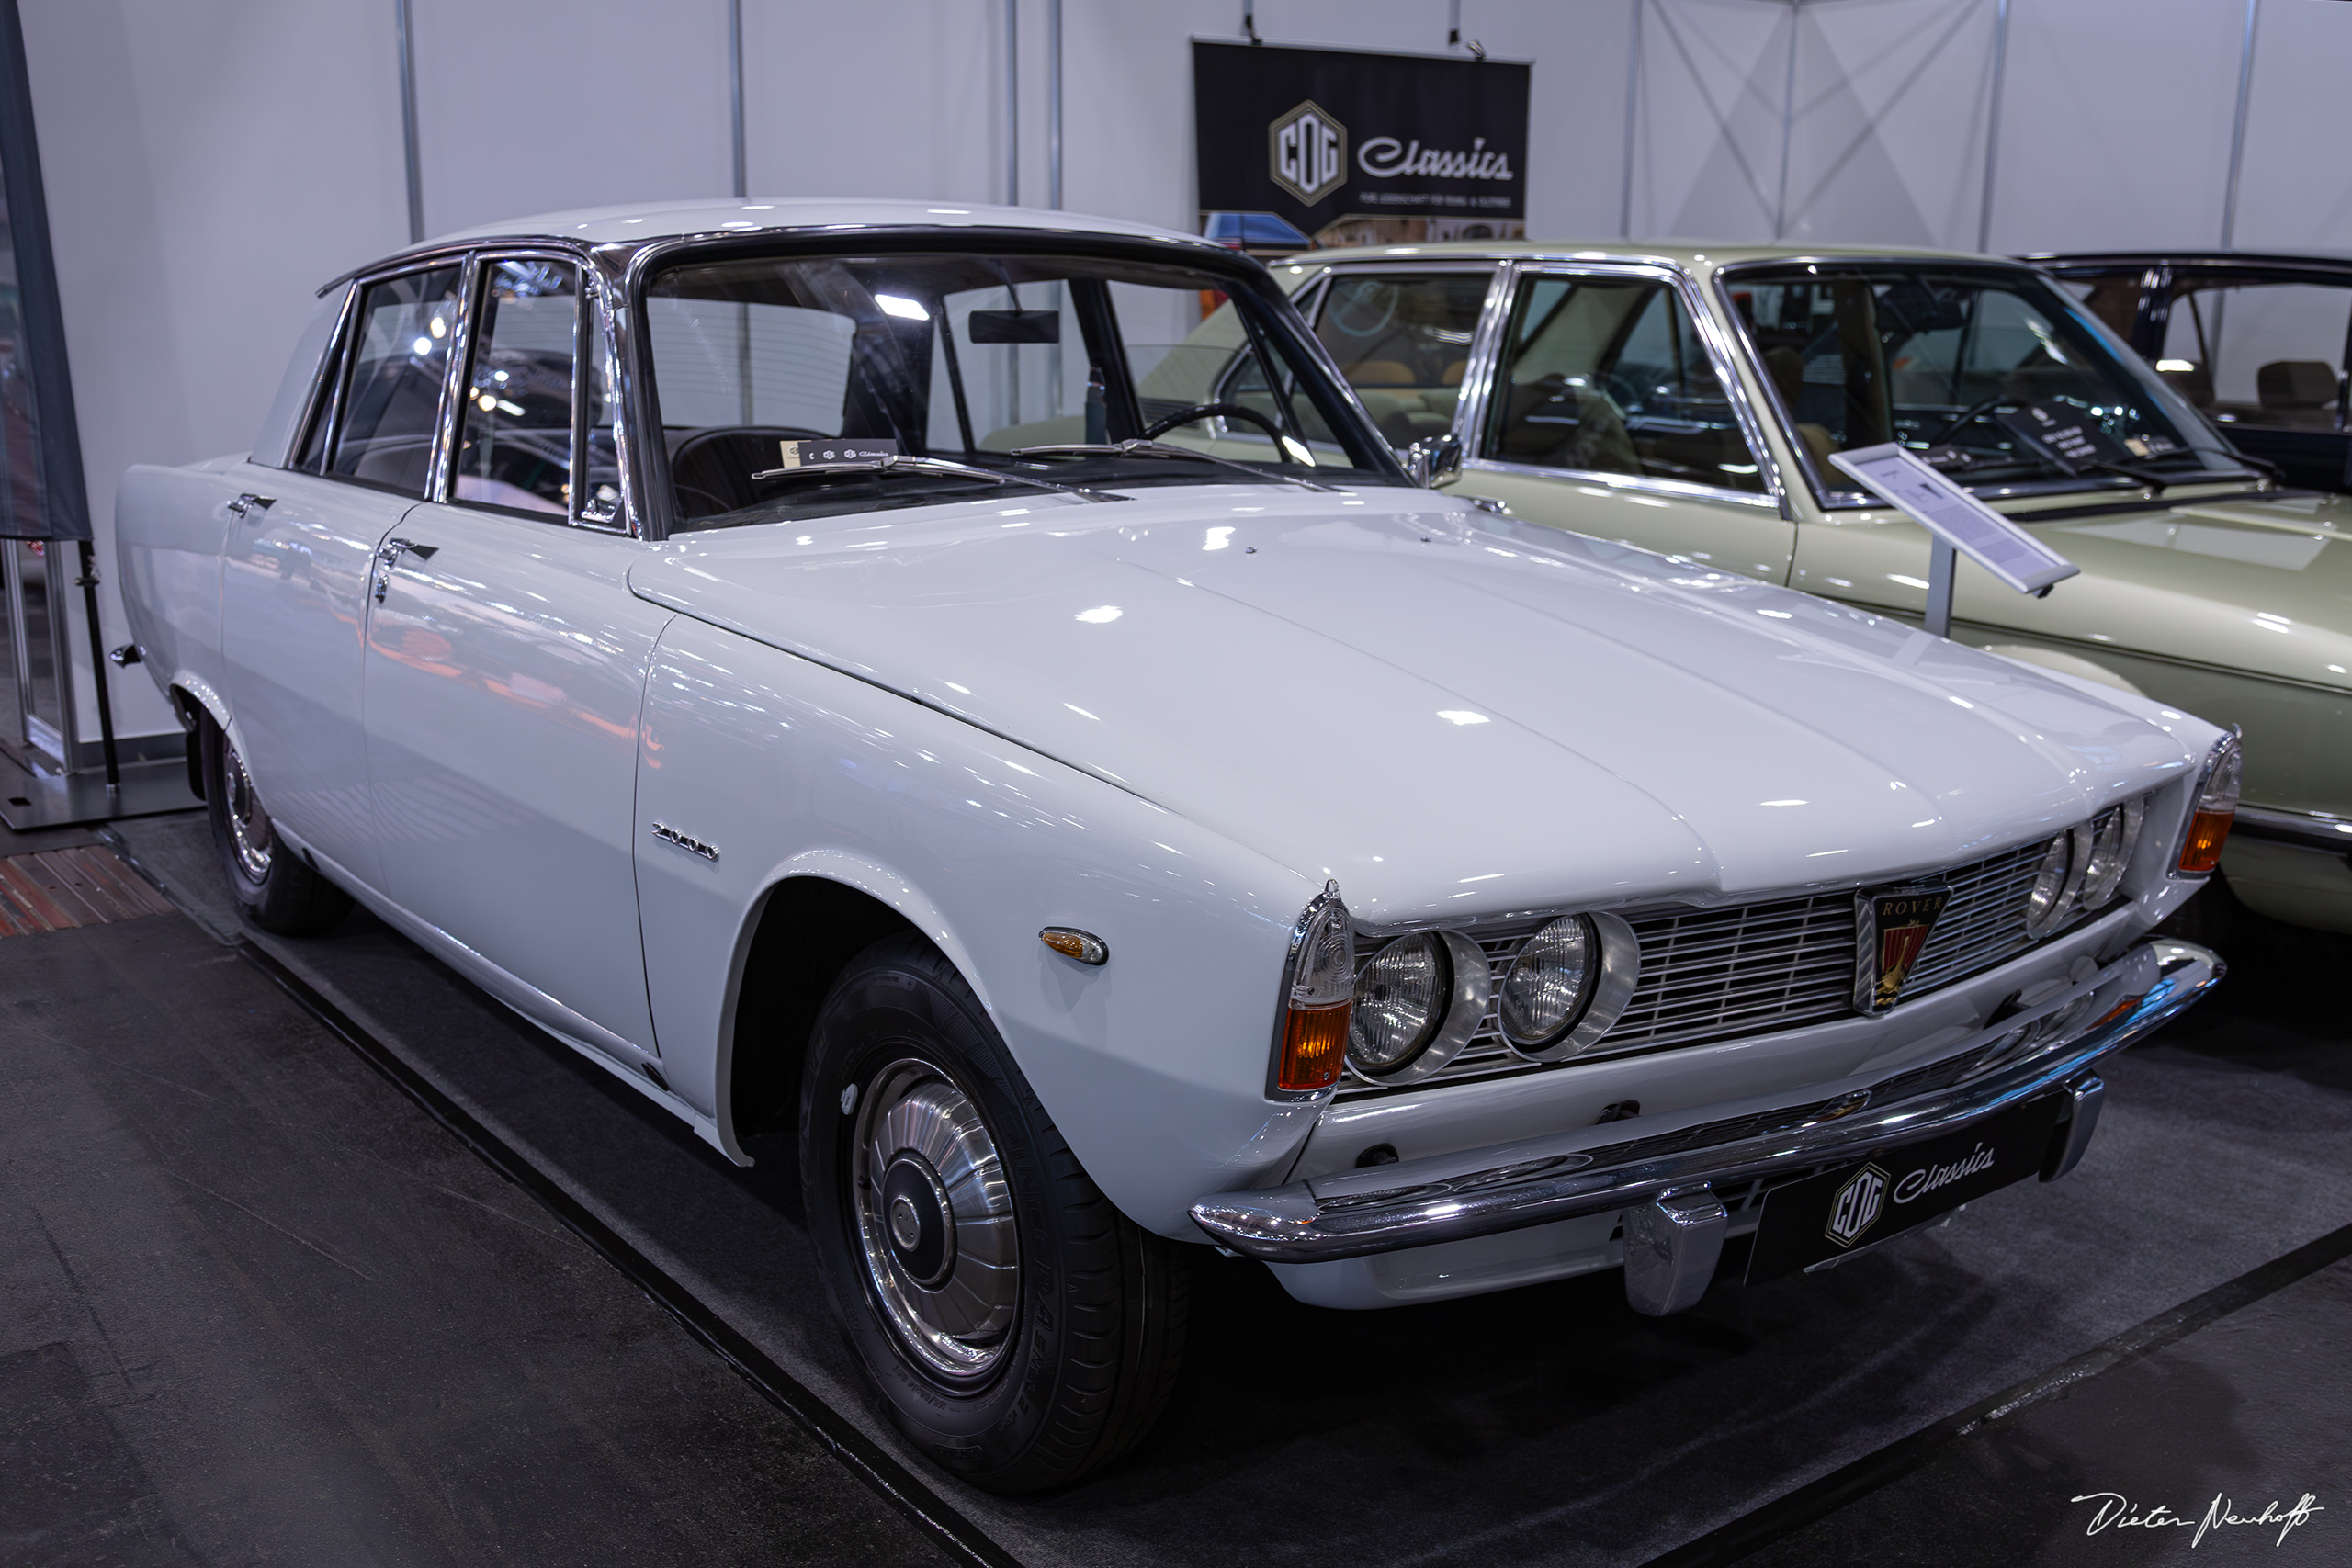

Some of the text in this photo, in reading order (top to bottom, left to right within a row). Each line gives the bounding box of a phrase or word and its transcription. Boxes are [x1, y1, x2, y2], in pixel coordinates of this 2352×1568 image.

[1278, 113, 1513, 194] COG Classics
[650, 821, 720, 863] 2000
[1882, 896, 1943, 916] ROVER
[1831, 1141, 1996, 1239] COG Classics
